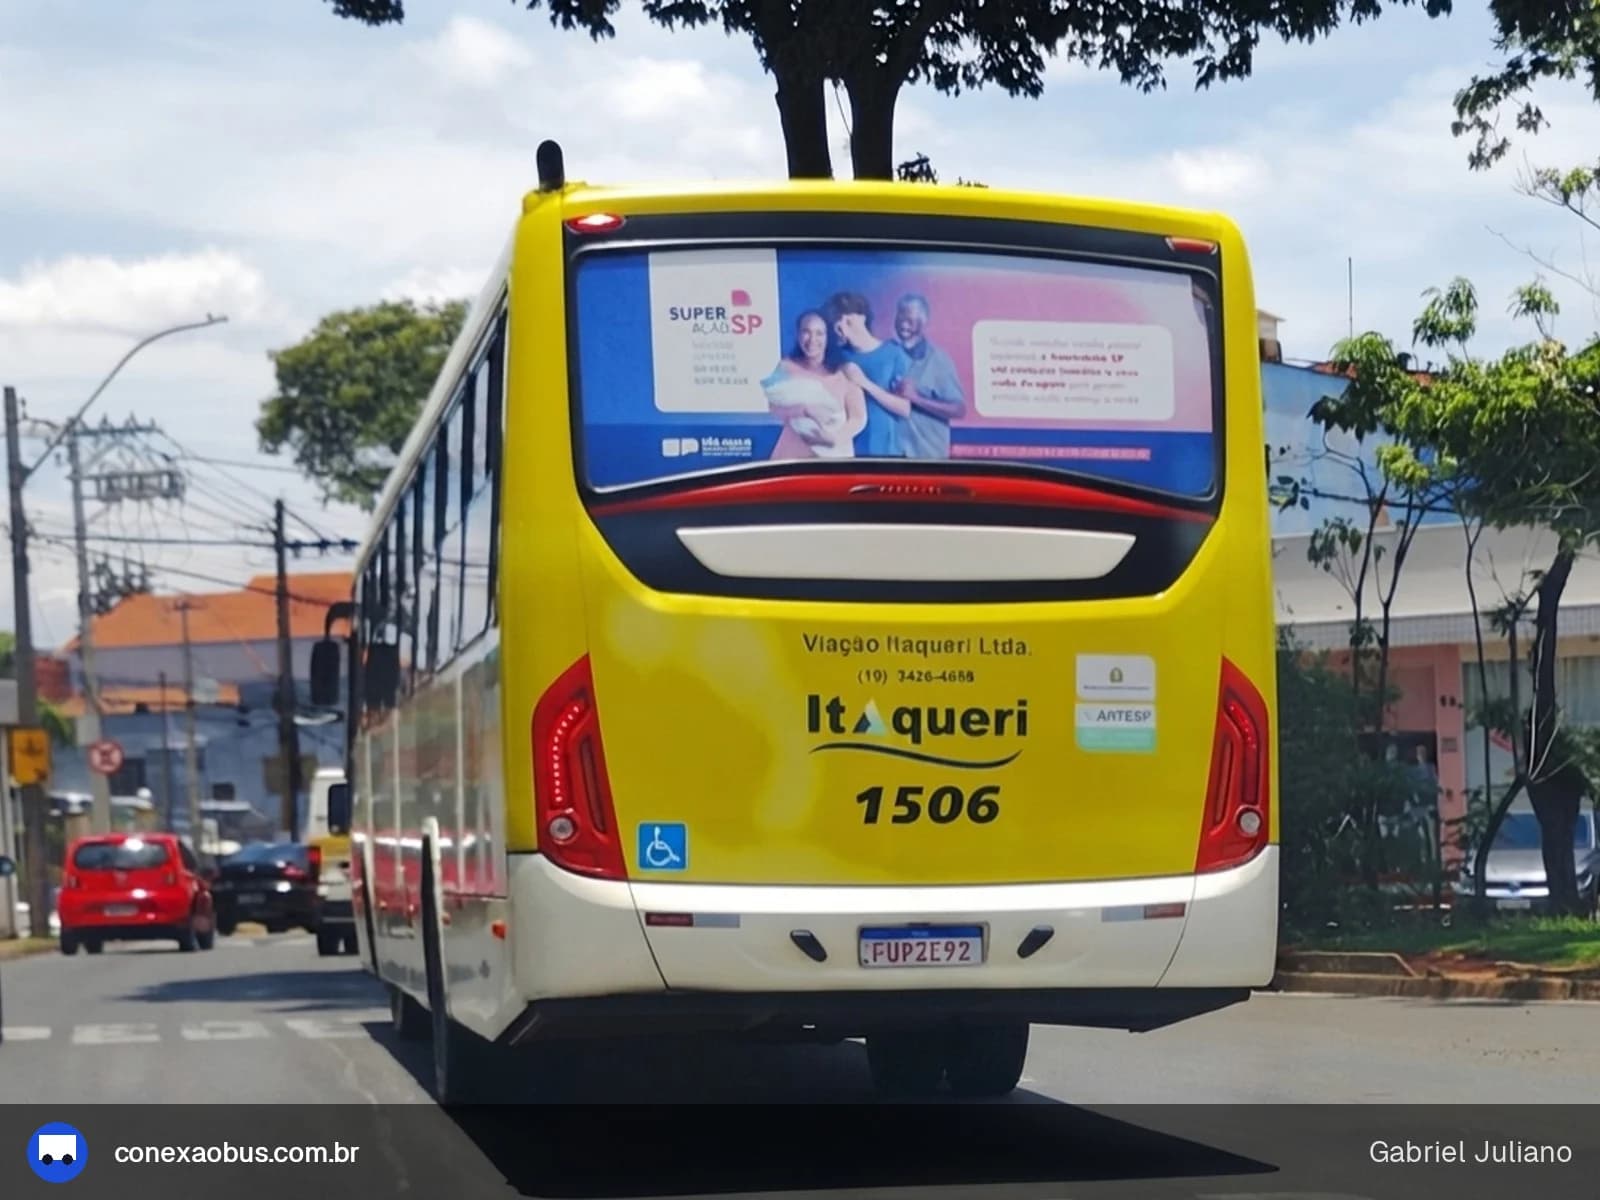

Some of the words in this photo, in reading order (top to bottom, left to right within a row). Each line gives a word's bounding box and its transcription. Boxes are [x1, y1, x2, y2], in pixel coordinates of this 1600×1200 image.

[669, 306, 726, 321] SUPER
[731, 314, 763, 335] SP
[803, 633, 880, 656] Viação
[856, 785, 1001, 824] 1506
[872, 941, 971, 963] FUP2E92
